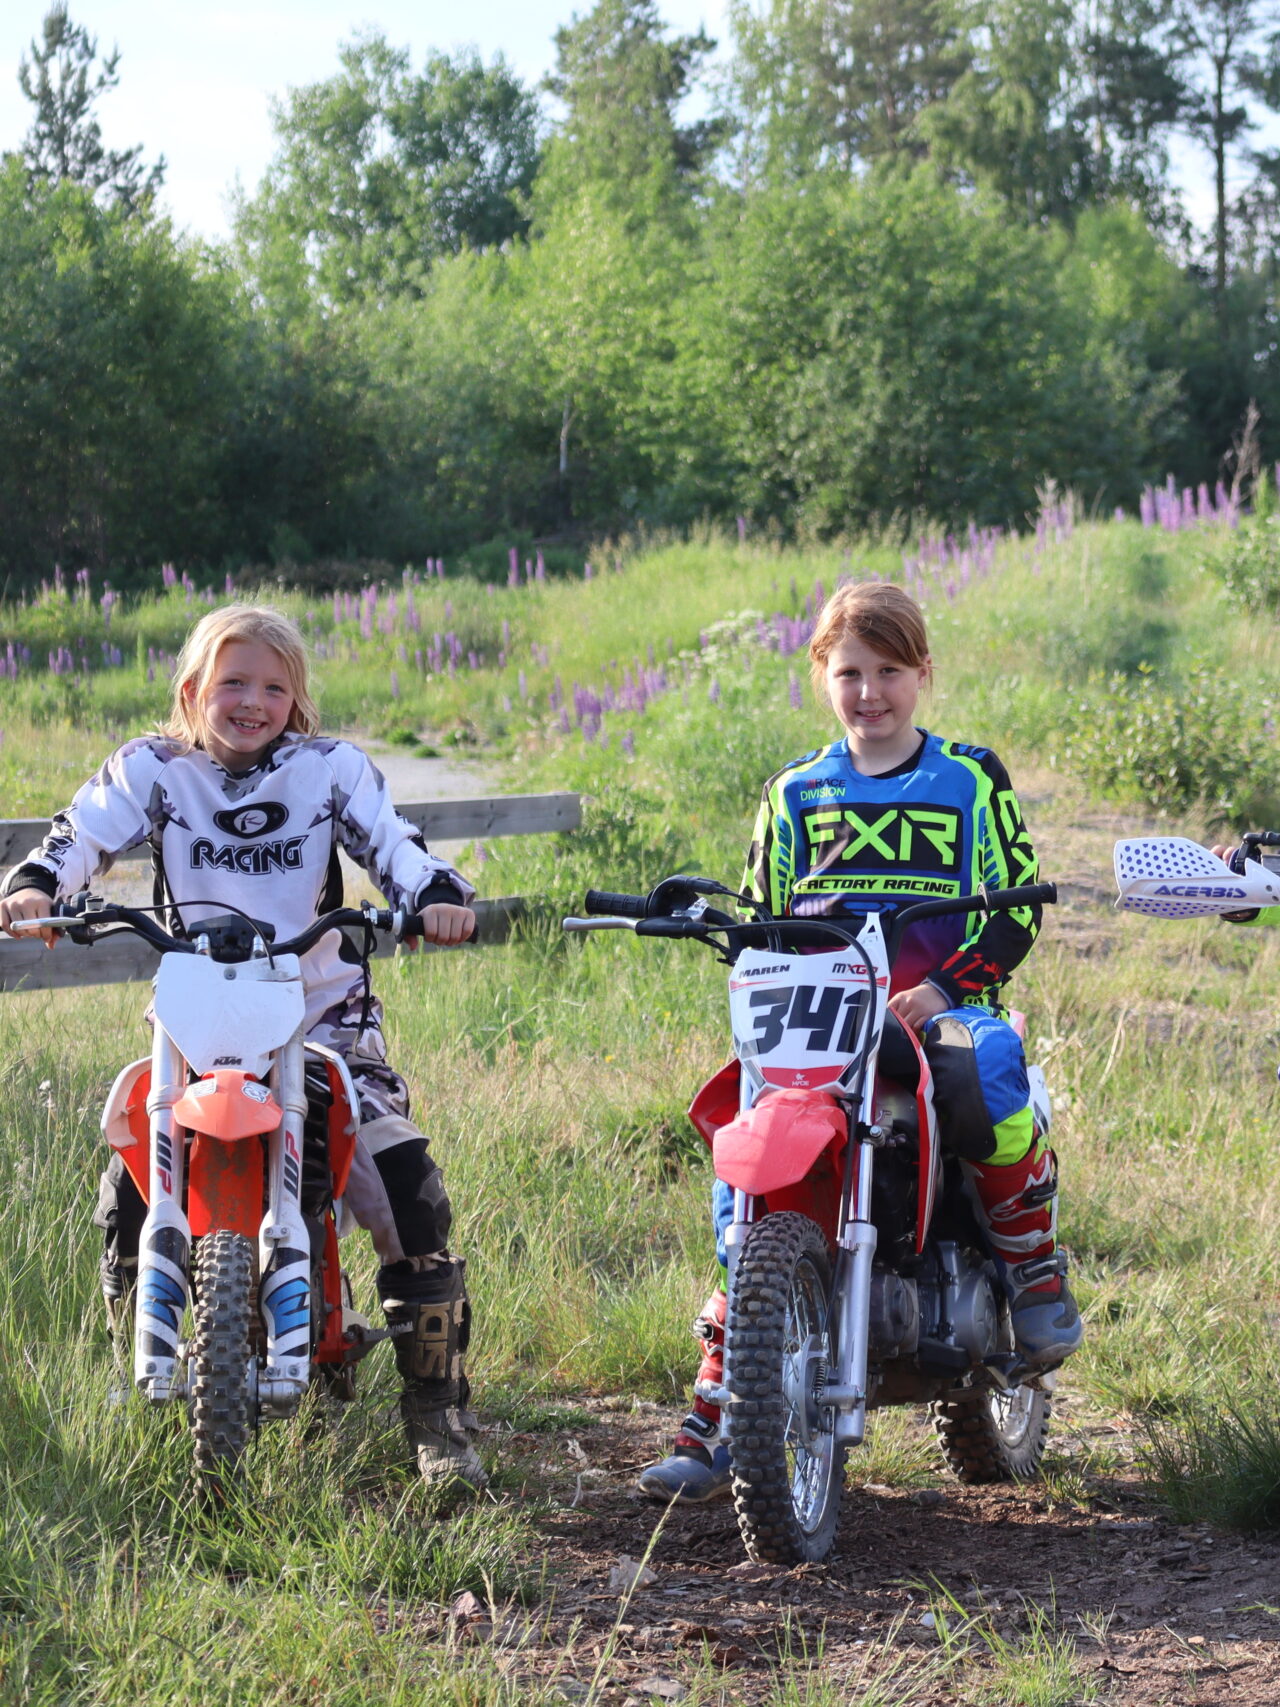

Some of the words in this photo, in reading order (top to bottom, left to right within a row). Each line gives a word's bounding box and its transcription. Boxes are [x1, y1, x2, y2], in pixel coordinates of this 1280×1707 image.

[815, 778, 847, 788] RACE
[800, 787, 846, 801] DIVISION
[804, 809, 958, 866] FXR
[190, 834, 310, 876] RACING
[798, 879, 878, 891] FACTORY
[882, 880, 956, 895] RACING
[738, 963, 791, 979] MAREN
[749, 985, 872, 1055] 341
[212, 1056, 243, 1066] KTM
